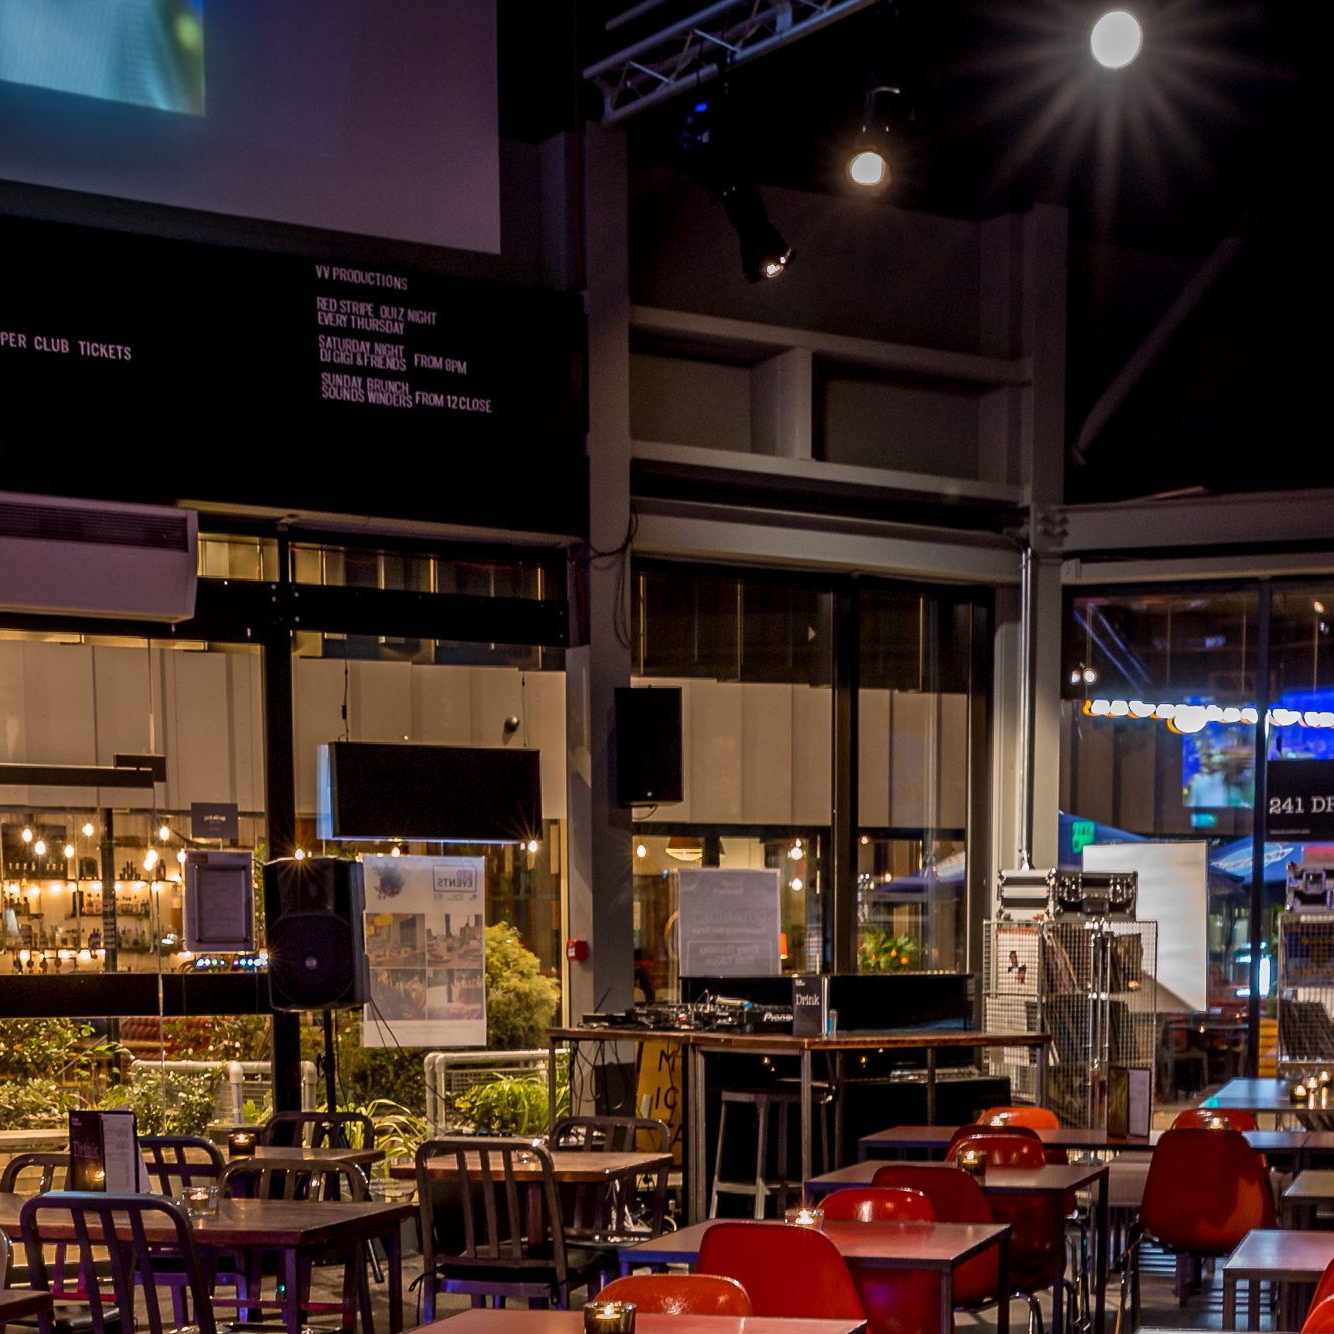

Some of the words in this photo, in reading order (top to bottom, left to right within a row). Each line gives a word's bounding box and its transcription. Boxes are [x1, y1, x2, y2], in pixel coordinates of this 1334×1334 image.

[315, 263, 330, 280] VV
[332, 266, 408, 291] PRODUCTIONS
[316, 295, 337, 312] RED
[339, 299, 374, 318] STRIPE
[379, 304, 405, 321] QUIZ
[407, 308, 438, 326] NIGHT
[317, 311, 348, 328] EVERY
[350, 315, 405, 336] THURSDAY
[33, 335, 70, 353] CLUB
[78, 340, 132, 361] TICKETS
[318, 333, 371, 355] SATURDAY
[374, 341, 405, 359] NIGHT
[319, 348, 331, 363] DJ
[356, 353, 364, 367] &
[364, 353, 407, 372] FRIENDS
[414, 352, 443, 371] FROM
[444, 357, 467, 375] 8PM
[321, 371, 363, 389] SUNDAY
[366, 376, 409, 393] BRUNCH
[321, 384, 365, 403] SOUNDS
[367, 390, 413, 409] WINDERS
[415, 390, 444, 408] FROM
[1268, 796, 1305, 815] 241
[795, 993, 820, 1006] Drink
[72, 1140, 99, 1159] Drink
